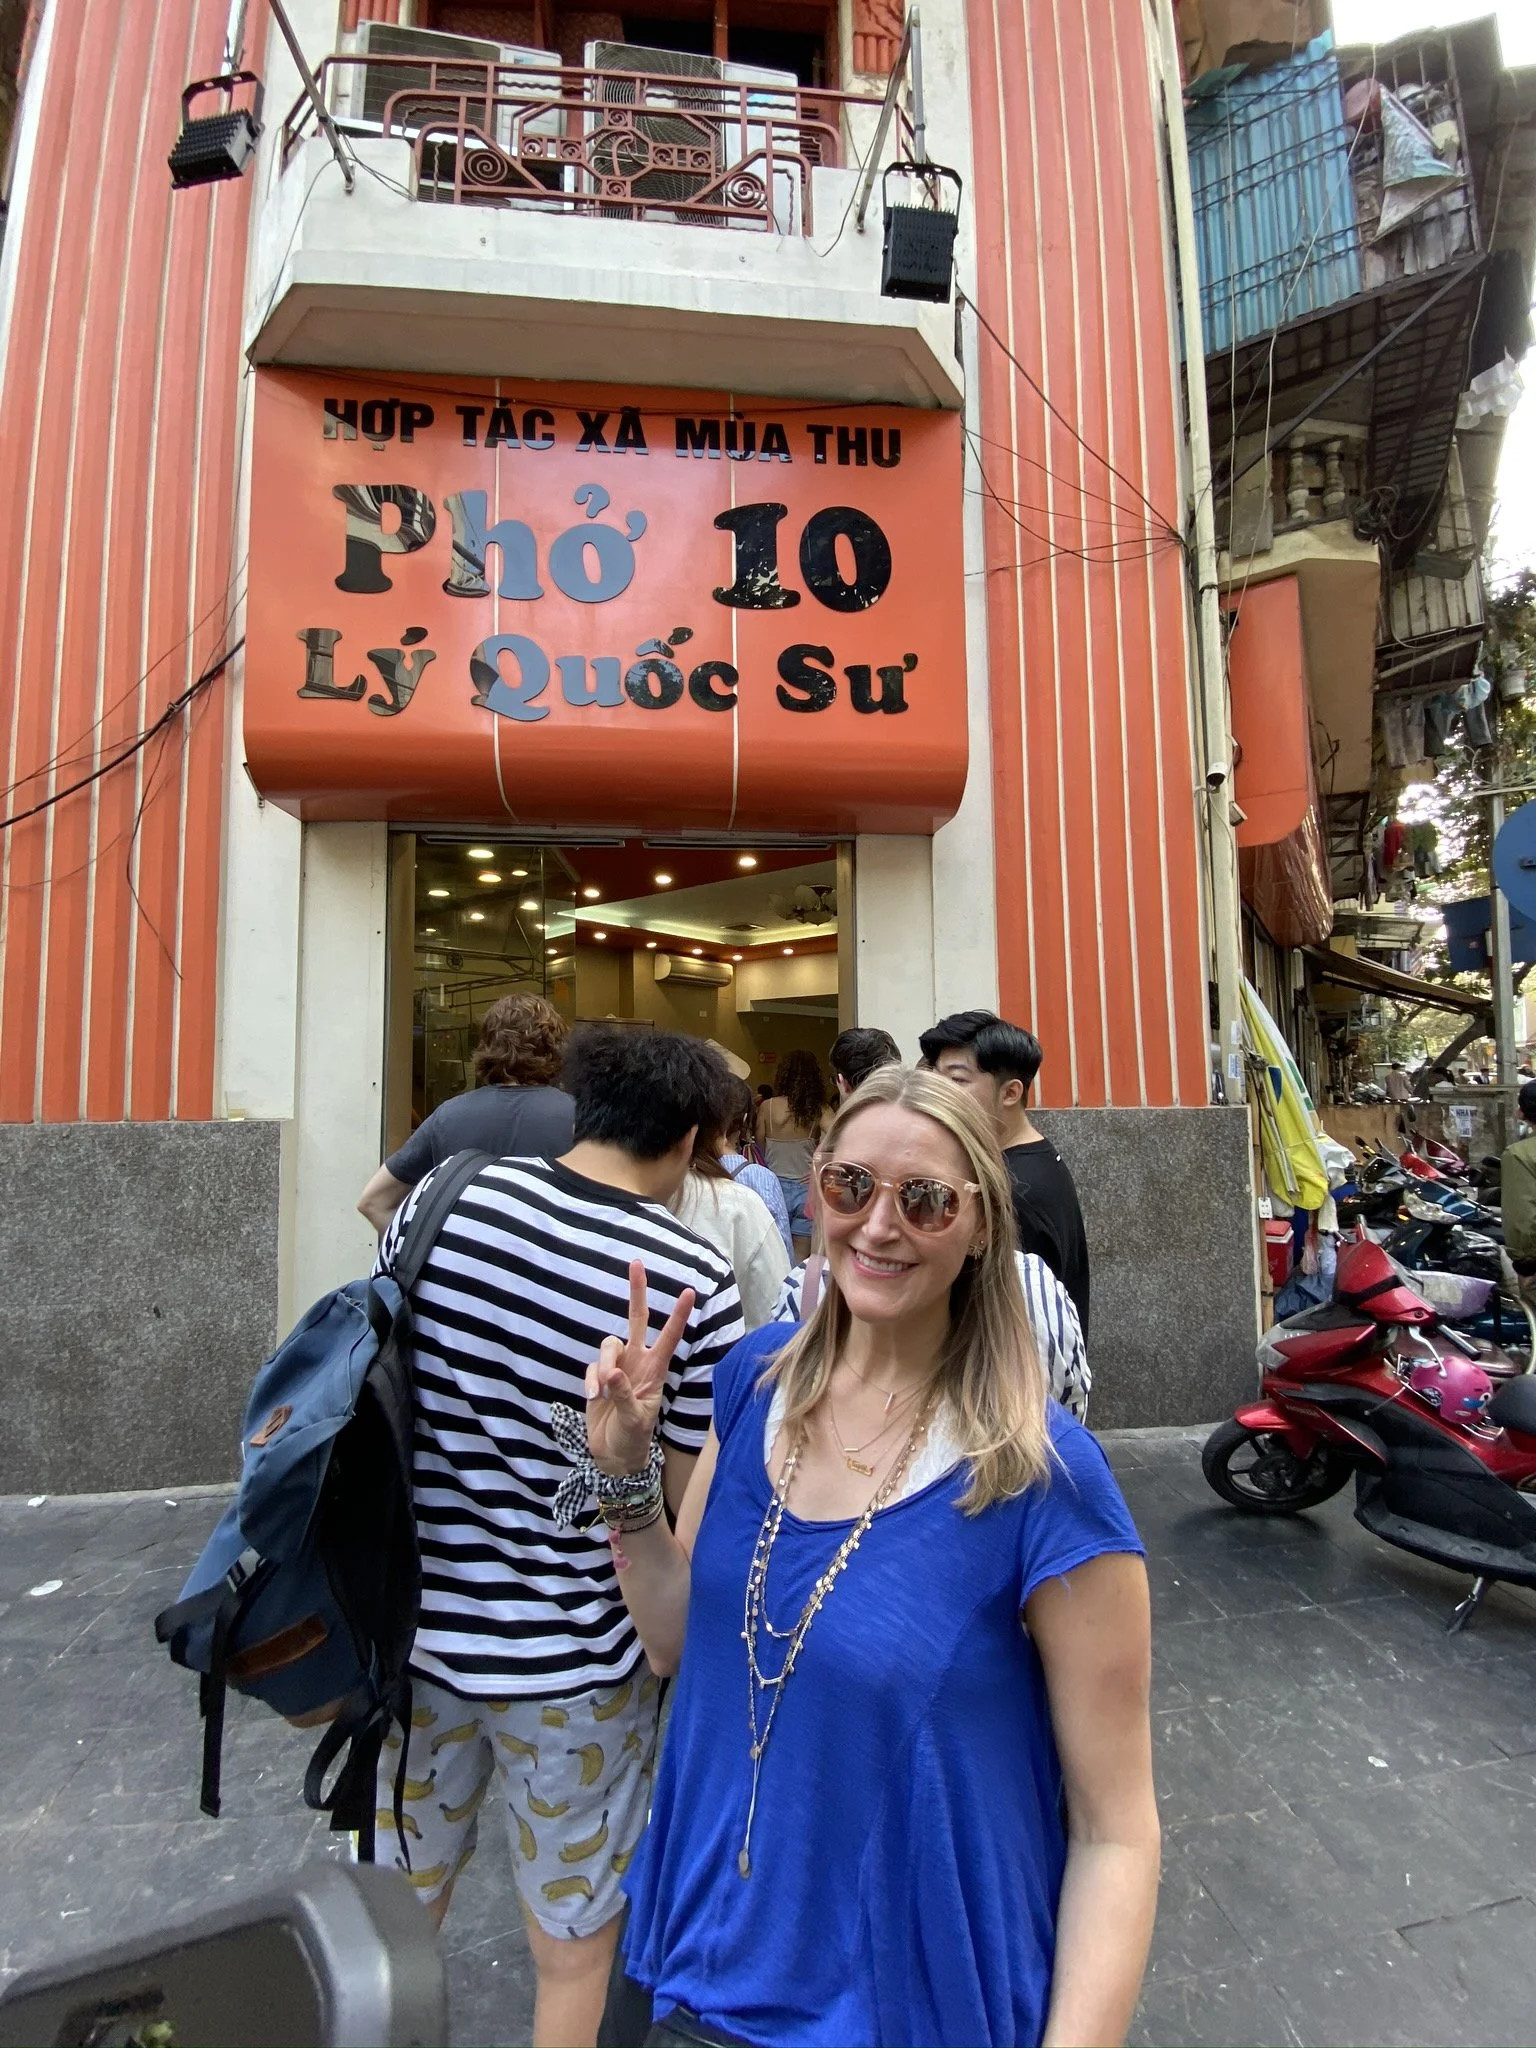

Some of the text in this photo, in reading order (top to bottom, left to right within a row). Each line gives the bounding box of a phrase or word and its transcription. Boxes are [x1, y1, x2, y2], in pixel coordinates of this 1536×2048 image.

[323, 397, 901, 468] HỢP TÁC XÃ MÙA THU
[332, 483, 892, 613] Phở 10
[297, 626, 918, 722] Lý Quốc Sư
